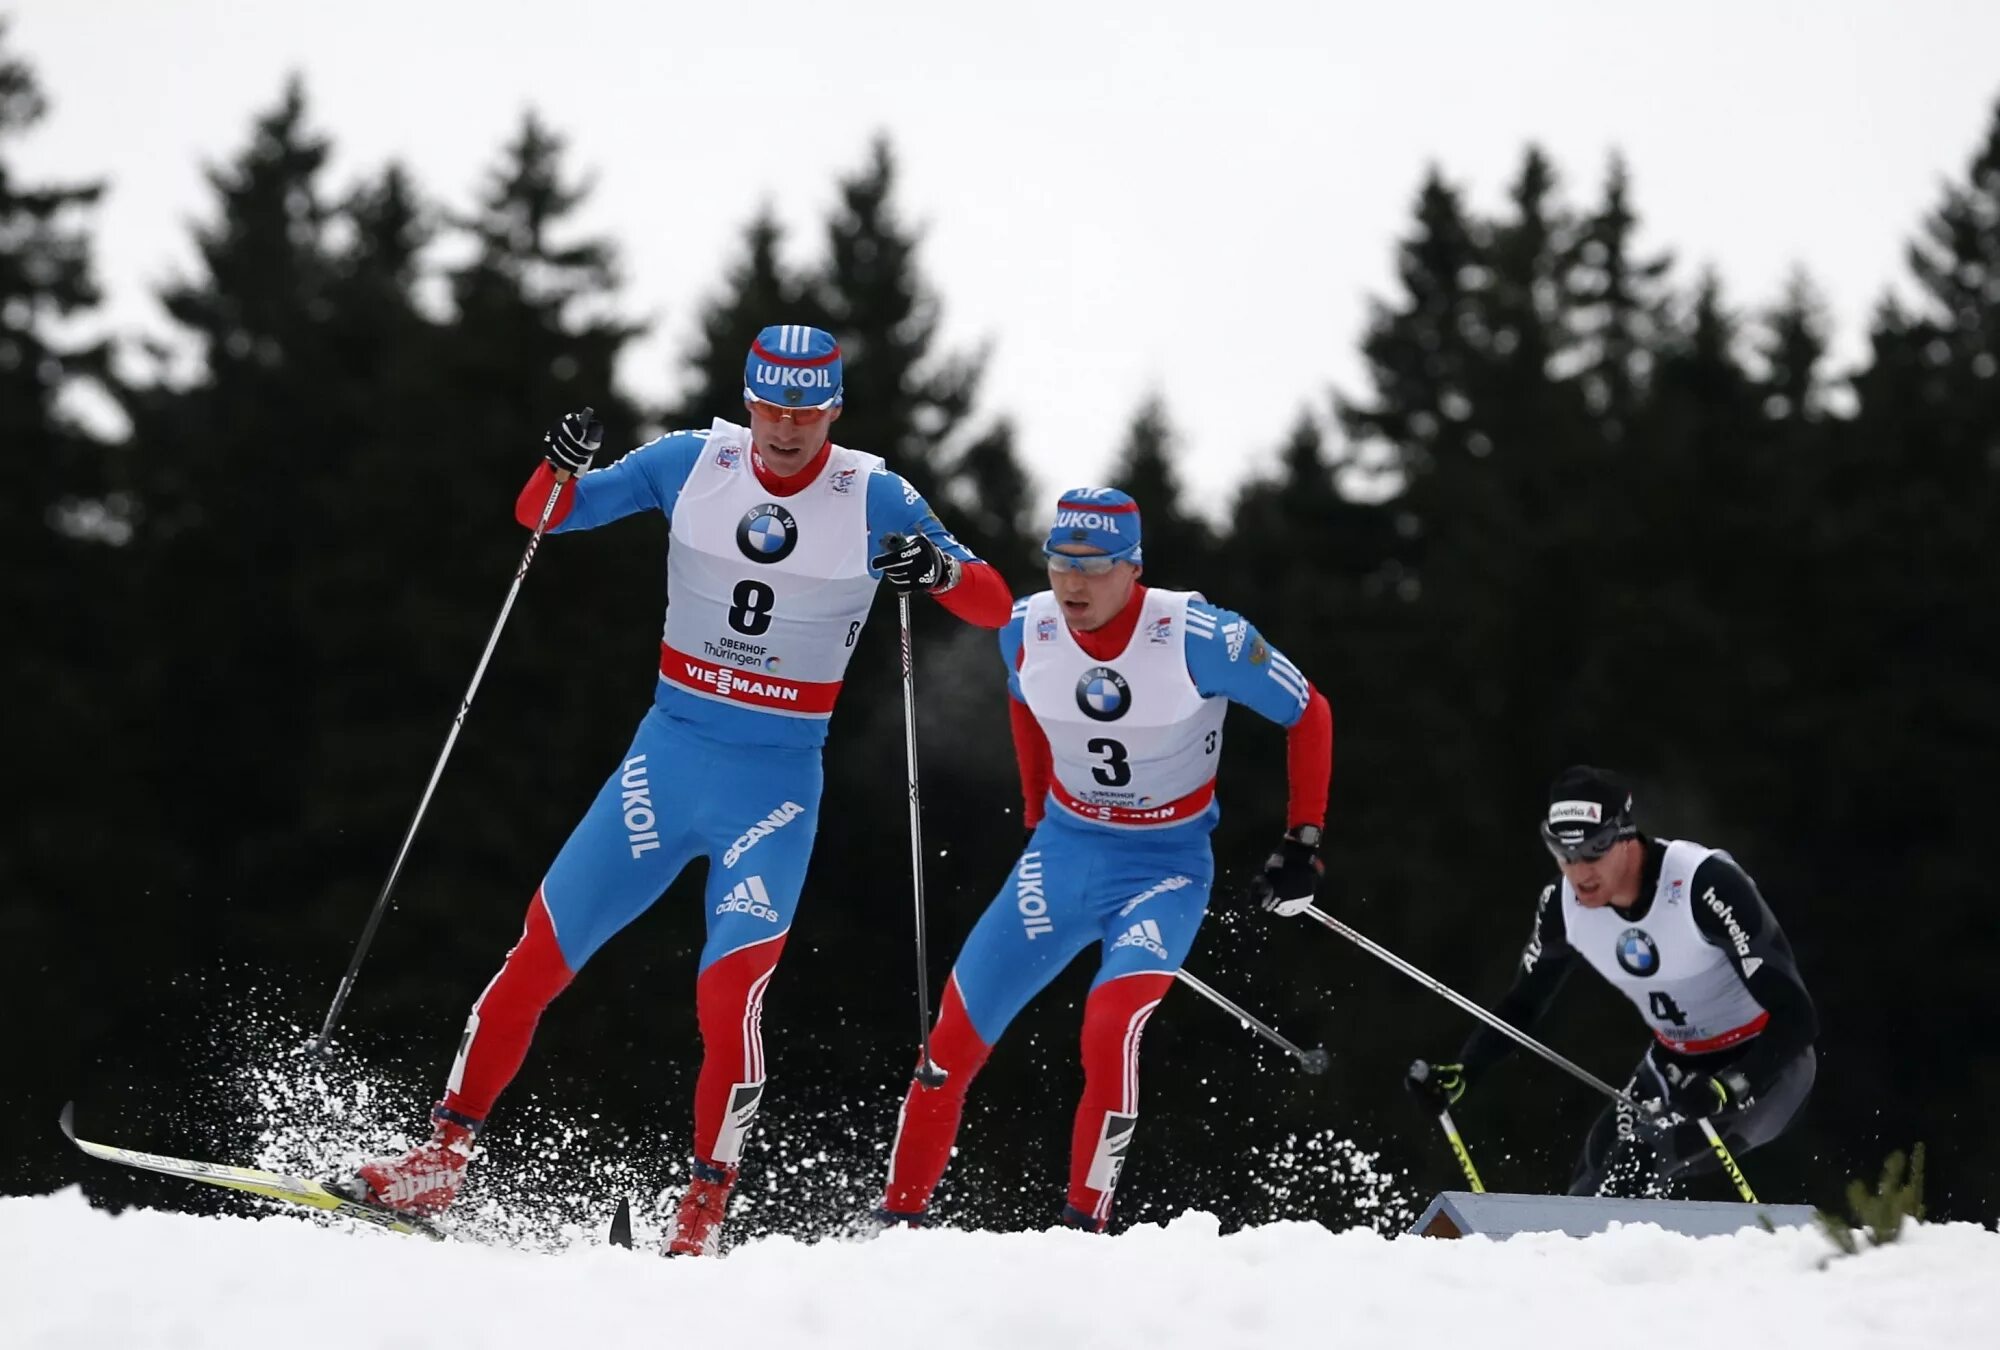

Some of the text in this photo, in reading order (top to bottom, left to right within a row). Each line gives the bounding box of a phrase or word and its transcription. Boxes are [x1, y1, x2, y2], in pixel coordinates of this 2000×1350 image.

[756, 364, 831, 388] LUKOIL
[747, 505, 796, 529] BMW
[728, 580, 775, 635] 8
[720, 637, 767, 656] OBERHOF
[845, 620, 860, 647] 8
[704, 641, 761, 666] Thüringen
[685, 662, 798, 701] VIESSMANN
[1081, 668, 1127, 688] BMW
[1205, 730, 1217, 755] 3
[1087, 738, 1131, 787] 3
[621, 754, 660, 859] LUKOIL
[722, 801, 804, 869] SCANIA
[716, 898, 778, 923] adidas
[1017, 851, 1053, 940] LUKOIL
[1702, 886, 1750, 957] helvetia
[1649, 992, 1687, 1026] 4
